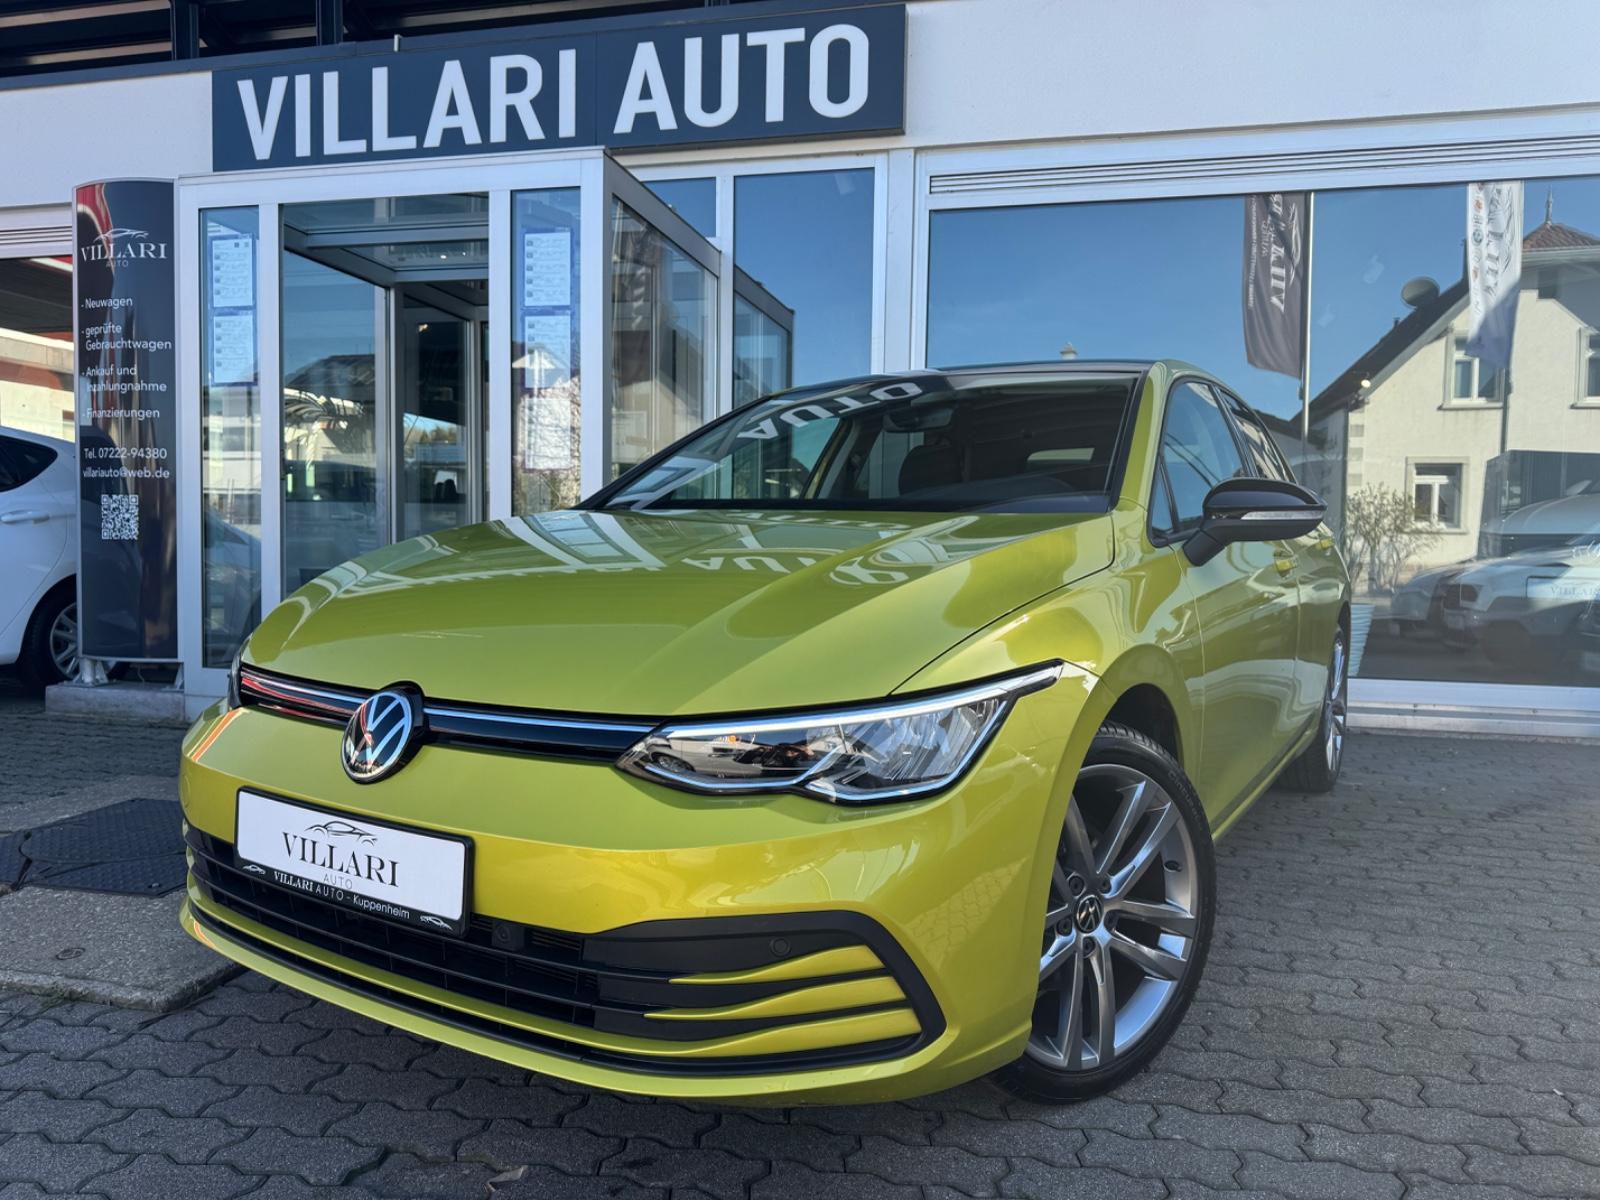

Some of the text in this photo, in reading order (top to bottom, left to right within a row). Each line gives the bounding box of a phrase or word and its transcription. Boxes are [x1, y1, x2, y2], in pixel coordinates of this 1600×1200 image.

[237, 23, 870, 160] VILLARI AUTO
[81, 242, 168, 262] VILLARI
[85, 297, 133, 310] Neuwagen
[85, 321, 122, 338] geprüfte
[85, 337, 172, 352] Gebrauchtwagen
[85, 363, 137, 377] Ankauf und
[86, 406, 160, 421] Finanzierungen
[83, 447, 168, 459] Tel. 07222-94380
[82, 465, 170, 478] villariauto@web.de
[282, 831, 400, 888] VILLARI
[323, 873, 353, 890] AUTO
[273, 870, 314, 892] VILLARI
[315, 884, 344, 901] AUTO
[353, 894, 411, 920] Kuppenheim
